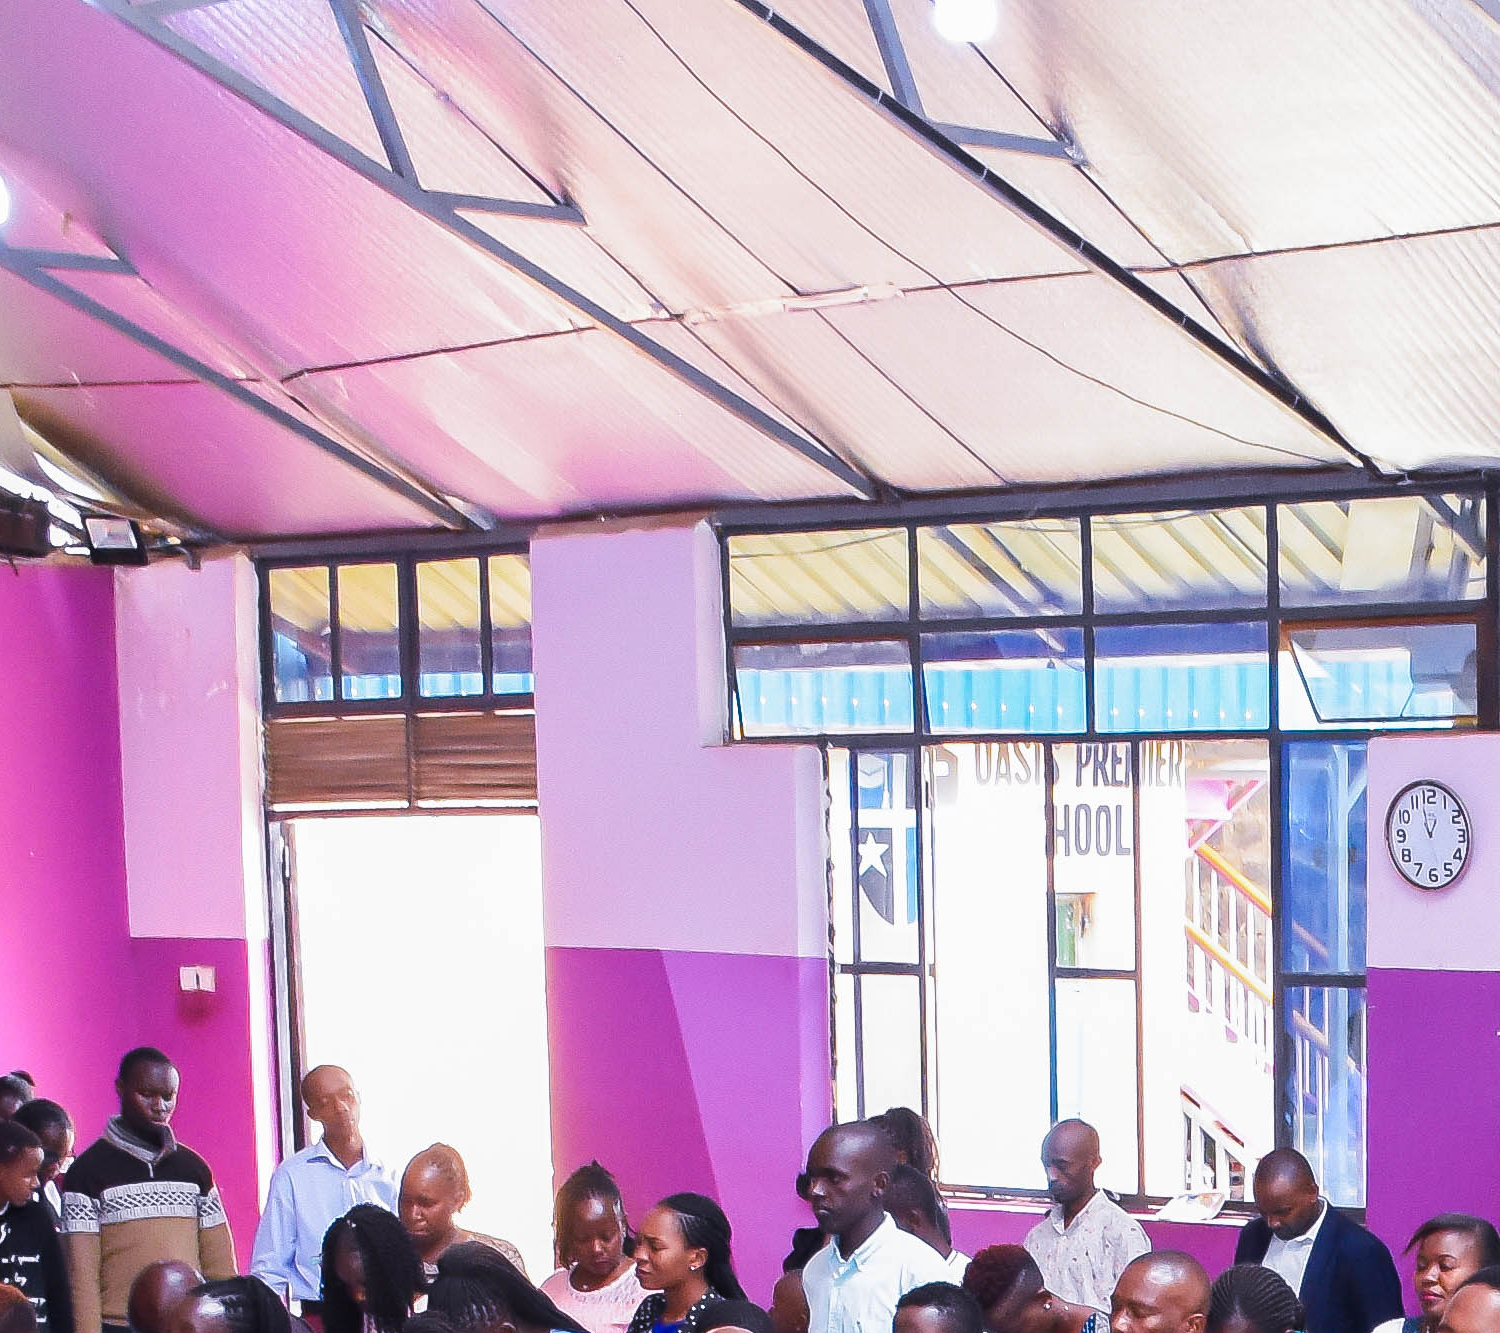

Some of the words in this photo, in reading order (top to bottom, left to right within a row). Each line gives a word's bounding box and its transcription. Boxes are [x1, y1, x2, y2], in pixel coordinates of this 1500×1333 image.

[975, 743, 1059, 785] OASI
[1410, 794, 1419, 810] 11
[1422, 789, 1437, 805] 12
[1442, 794, 1447, 810] 1
[1398, 809, 1411, 825] 10
[1396, 828, 1407, 844] 9
[1456, 828, 1467, 844] 3
[1401, 848, 1412, 863] 8
[1452, 847, 1463, 863] 4
[1413, 862, 1423, 878] 7
[1428, 867, 1439, 883] 6
[1443, 862, 1454, 878] 5
